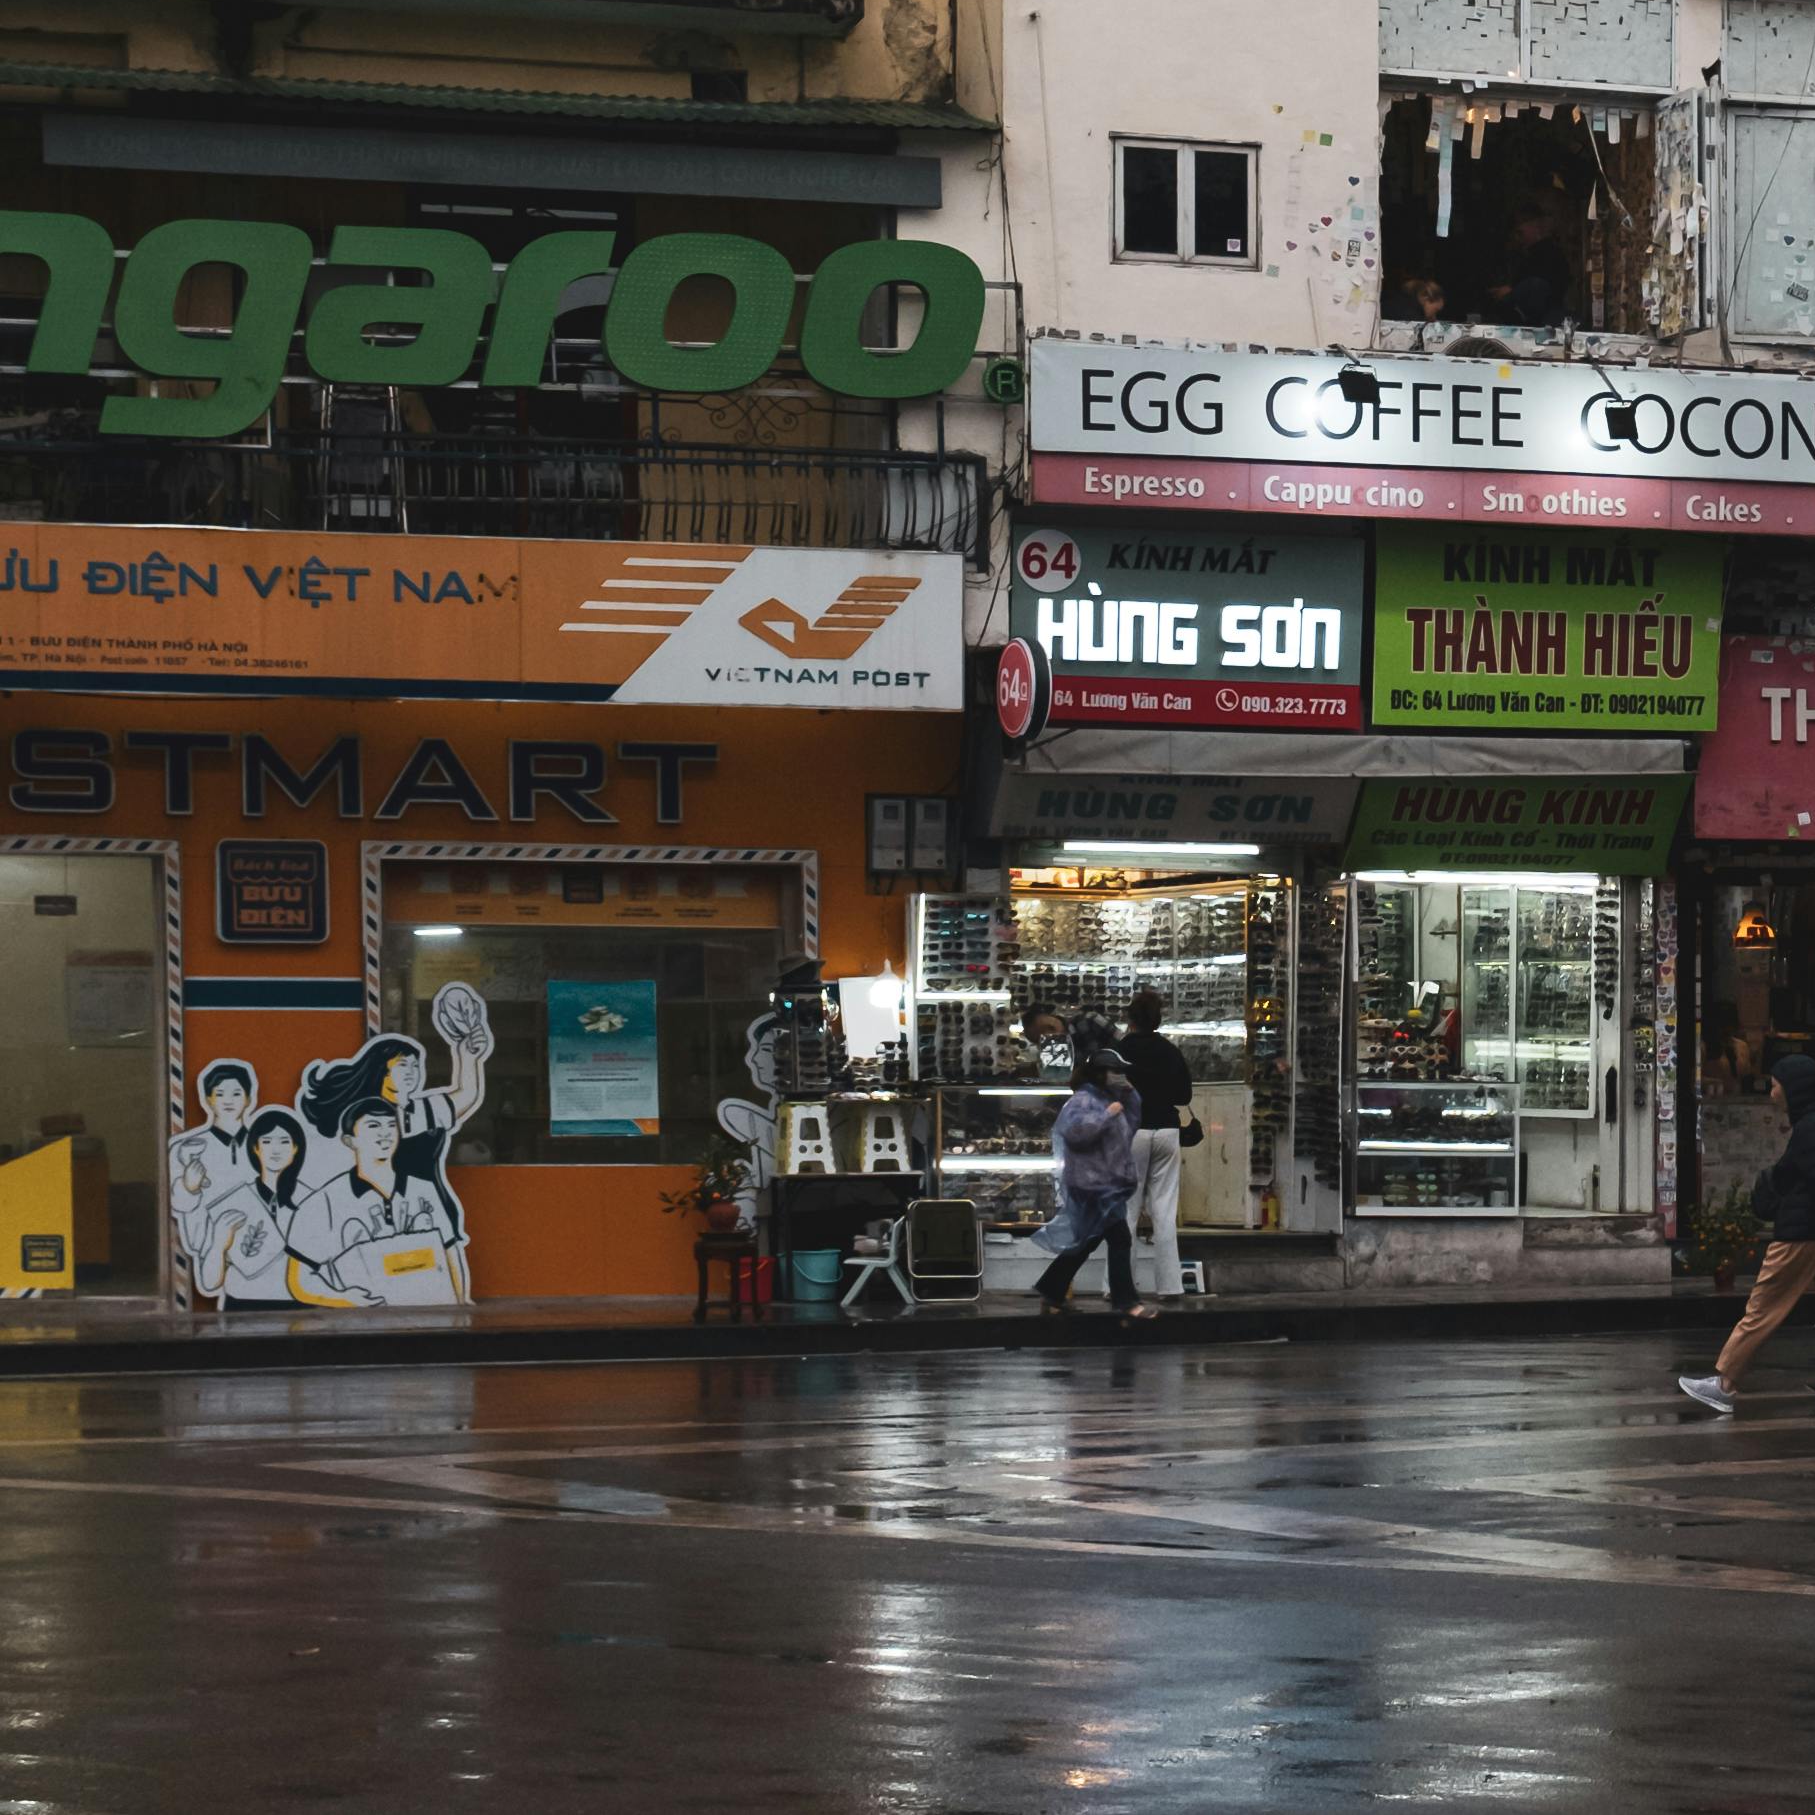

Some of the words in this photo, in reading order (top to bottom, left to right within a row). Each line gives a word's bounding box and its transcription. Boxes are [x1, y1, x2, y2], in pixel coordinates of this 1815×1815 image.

[1081, 368, 1224, 435] EGG
[1265, 376, 1524, 448] COFFEE
[1084, 466, 1205, 501] Espresso
[1482, 485, 1627, 517] Smoothies
[1686, 495, 1762, 523] Cakes
[1021, 541, 1077, 580] 64
[1107, 536, 1194, 571] KÍNH
[1201, 537, 1277, 575] MẮT
[1443, 538, 1551, 584] KÍNH
[1565, 536, 1661, 587] MẮT
[82, 550, 218, 604] ĐIỆN
[243, 555, 371, 608] VỆT
[1405, 594, 1568, 676] THÀNH
[1582, 592, 1693, 680] HIẾU
[853, 670, 931, 688] POST
[1054, 690, 1074, 707] 64
[1163, 692, 1192, 711] Can
[1241, 696, 1346, 715] 090.323.7773
[1422, 690, 1442, 711] 64
[1447, 690, 1496, 716] Lương
[1500, 690, 1530, 712] Văn
[1534, 692, 1565, 713] Can
[1608, 694, 1705, 716] 0902194077
[9, 729, 719, 823] STMART
[1036, 783, 1179, 821] HÙNG
[1207, 794, 1314, 823] SƠN
[1537, 782, 1655, 825] KÍNH
